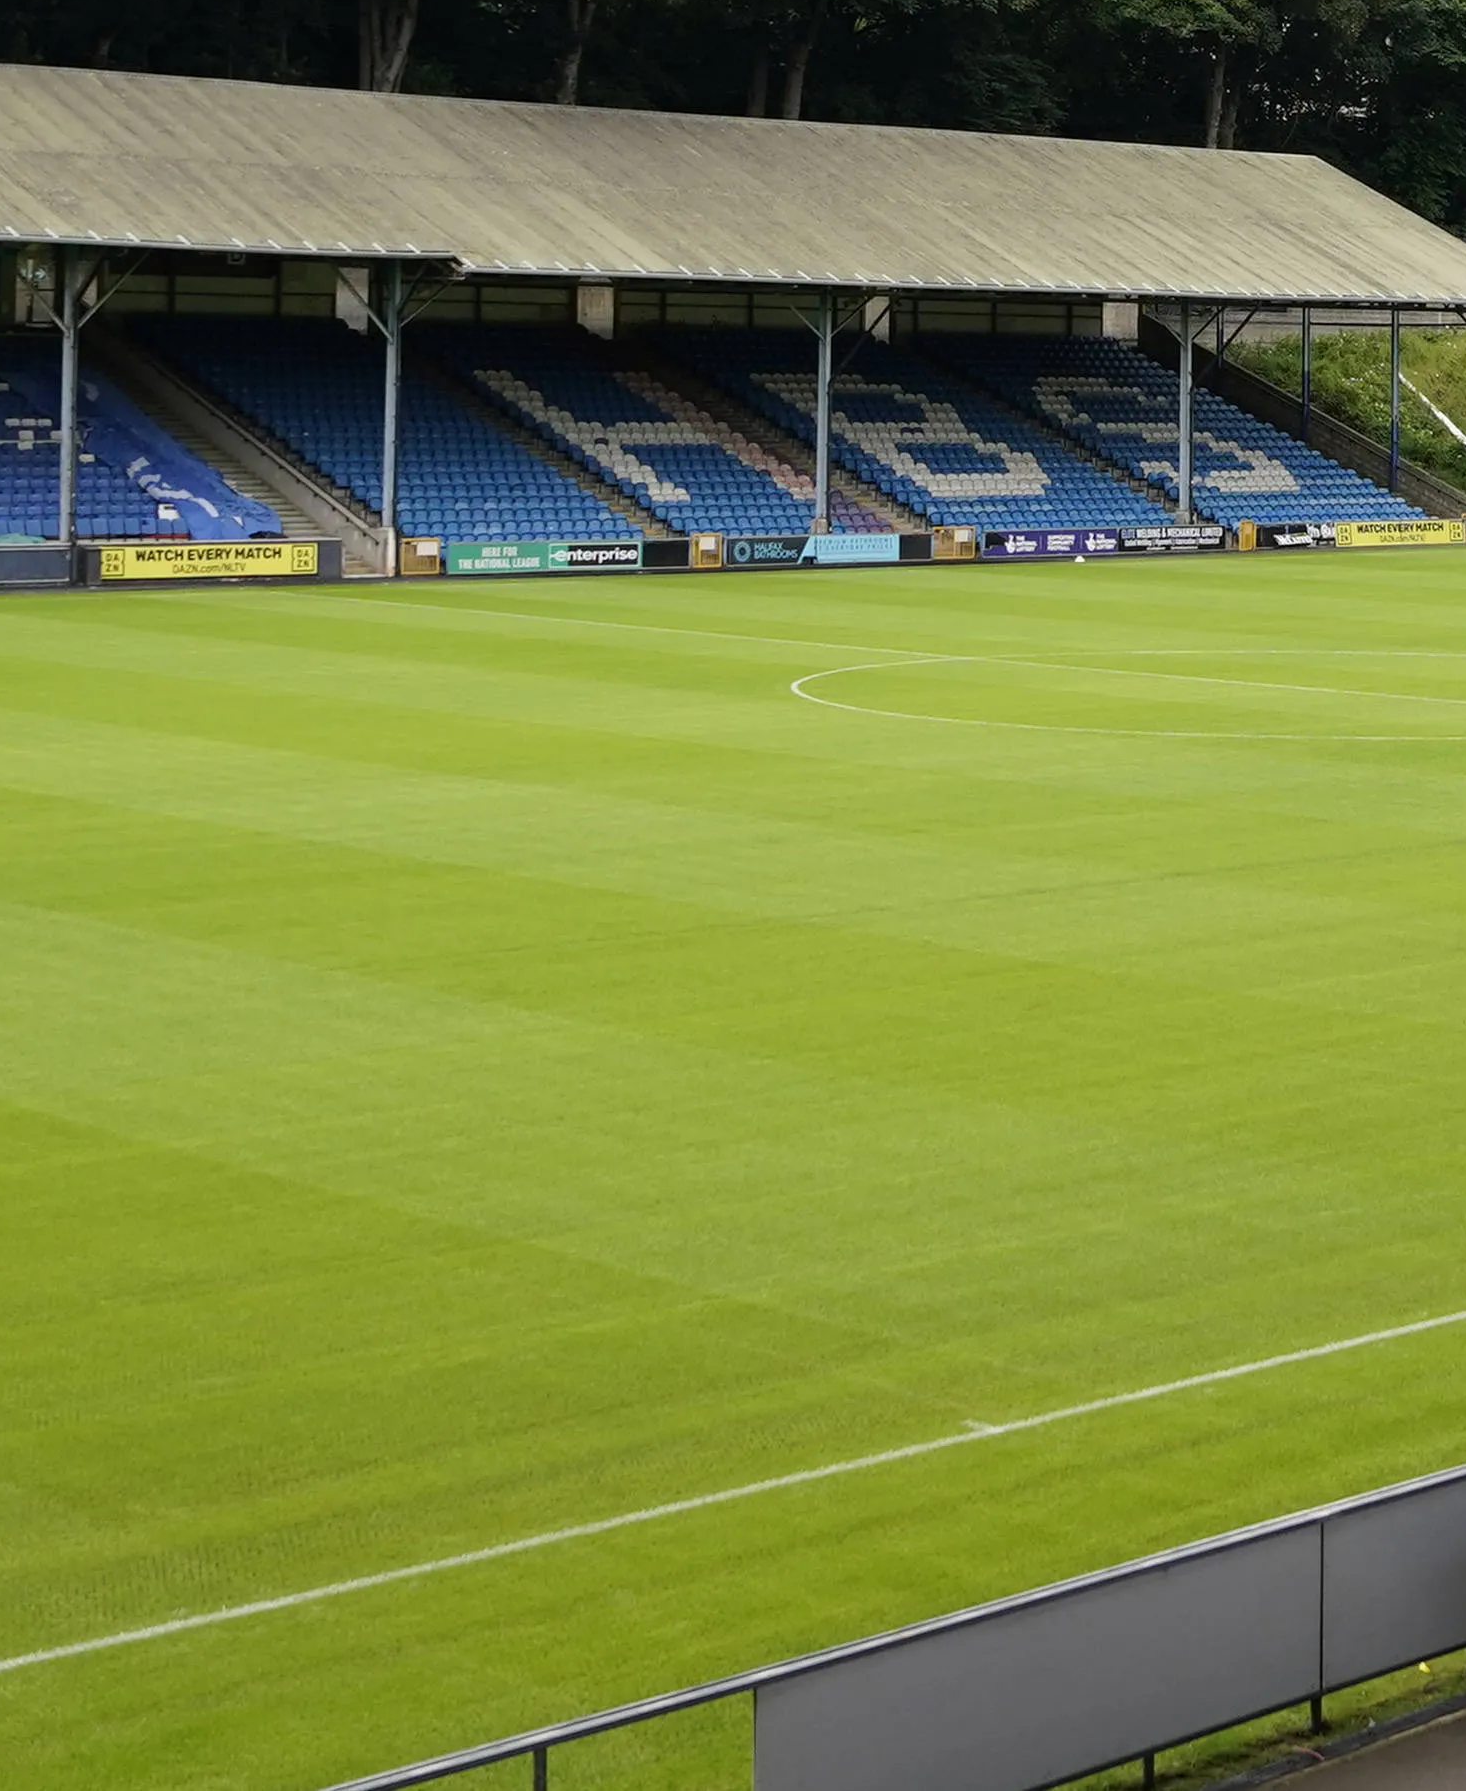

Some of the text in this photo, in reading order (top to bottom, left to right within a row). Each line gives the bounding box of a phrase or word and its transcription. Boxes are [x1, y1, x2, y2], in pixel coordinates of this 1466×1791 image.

[1387, 524, 1415, 533] EVERY
[136, 547, 282, 562] WATCH EVERY MATCH
[553, 547, 638, 563] enterprise
